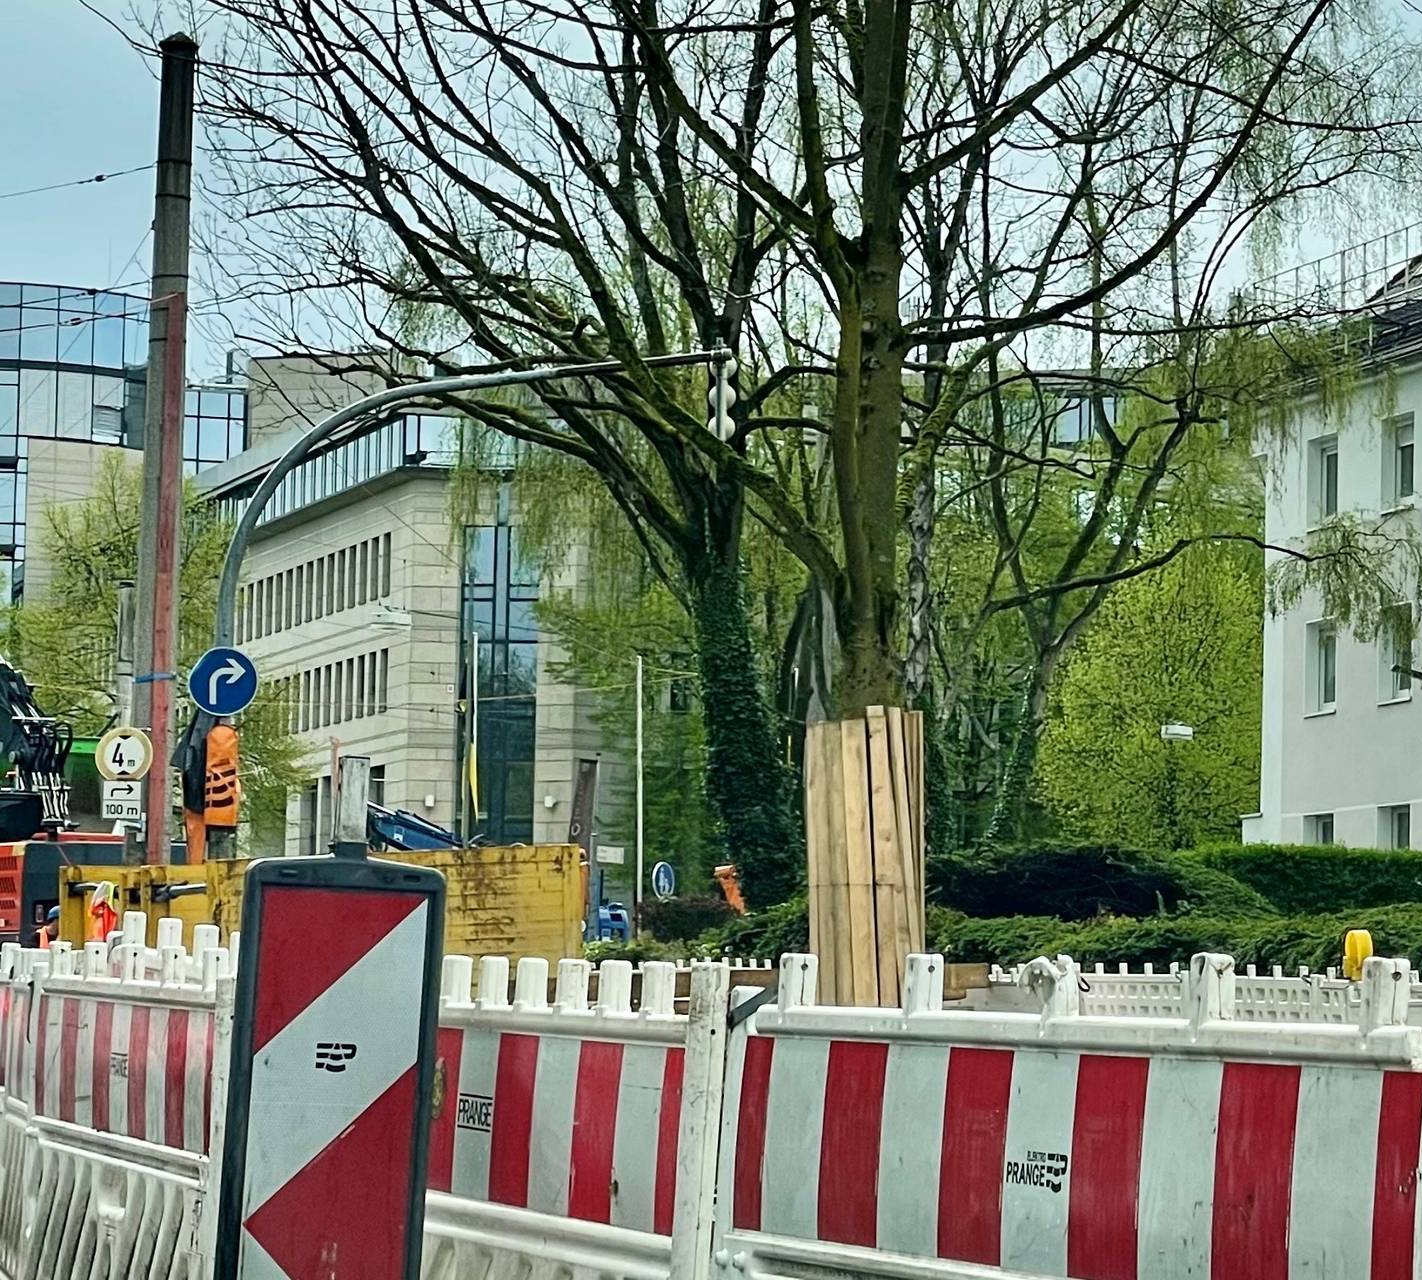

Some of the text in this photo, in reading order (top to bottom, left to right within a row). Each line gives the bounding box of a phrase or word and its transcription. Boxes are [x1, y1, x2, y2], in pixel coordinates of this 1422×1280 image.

[111, 742, 125, 768] 4
[105, 803, 139, 816] 100 m
[457, 1098, 493, 1128] PRANGE
[1006, 1161, 1046, 1187] PRANGE
